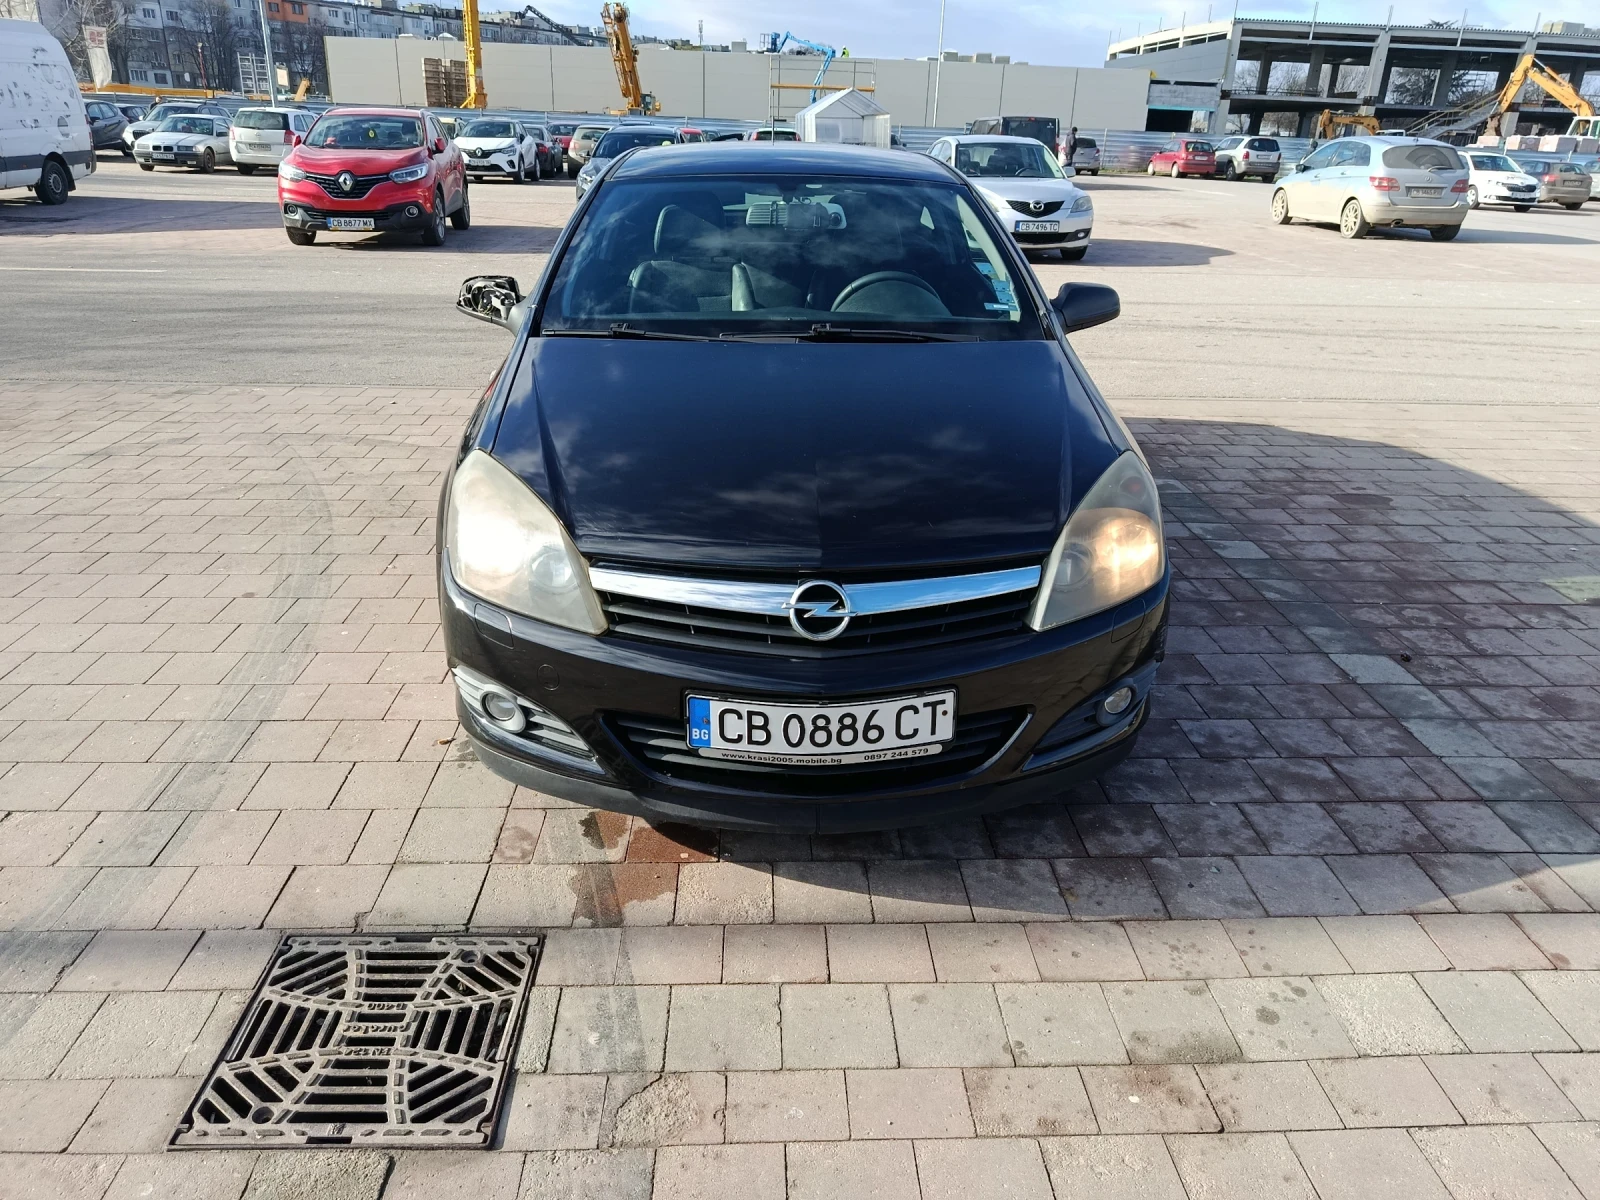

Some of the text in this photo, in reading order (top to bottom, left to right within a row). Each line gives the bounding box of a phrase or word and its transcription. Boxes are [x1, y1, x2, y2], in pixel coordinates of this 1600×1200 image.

[332, 219, 373, 227] CB 8877 MX
[1020, 223, 1058, 231] CB 7496 TC
[717, 699, 946, 748] CB 0886 CT
[691, 727, 709, 741] BG
[721, 748, 929, 765] www.krasi2005.mobile.bg 0897 244 579
